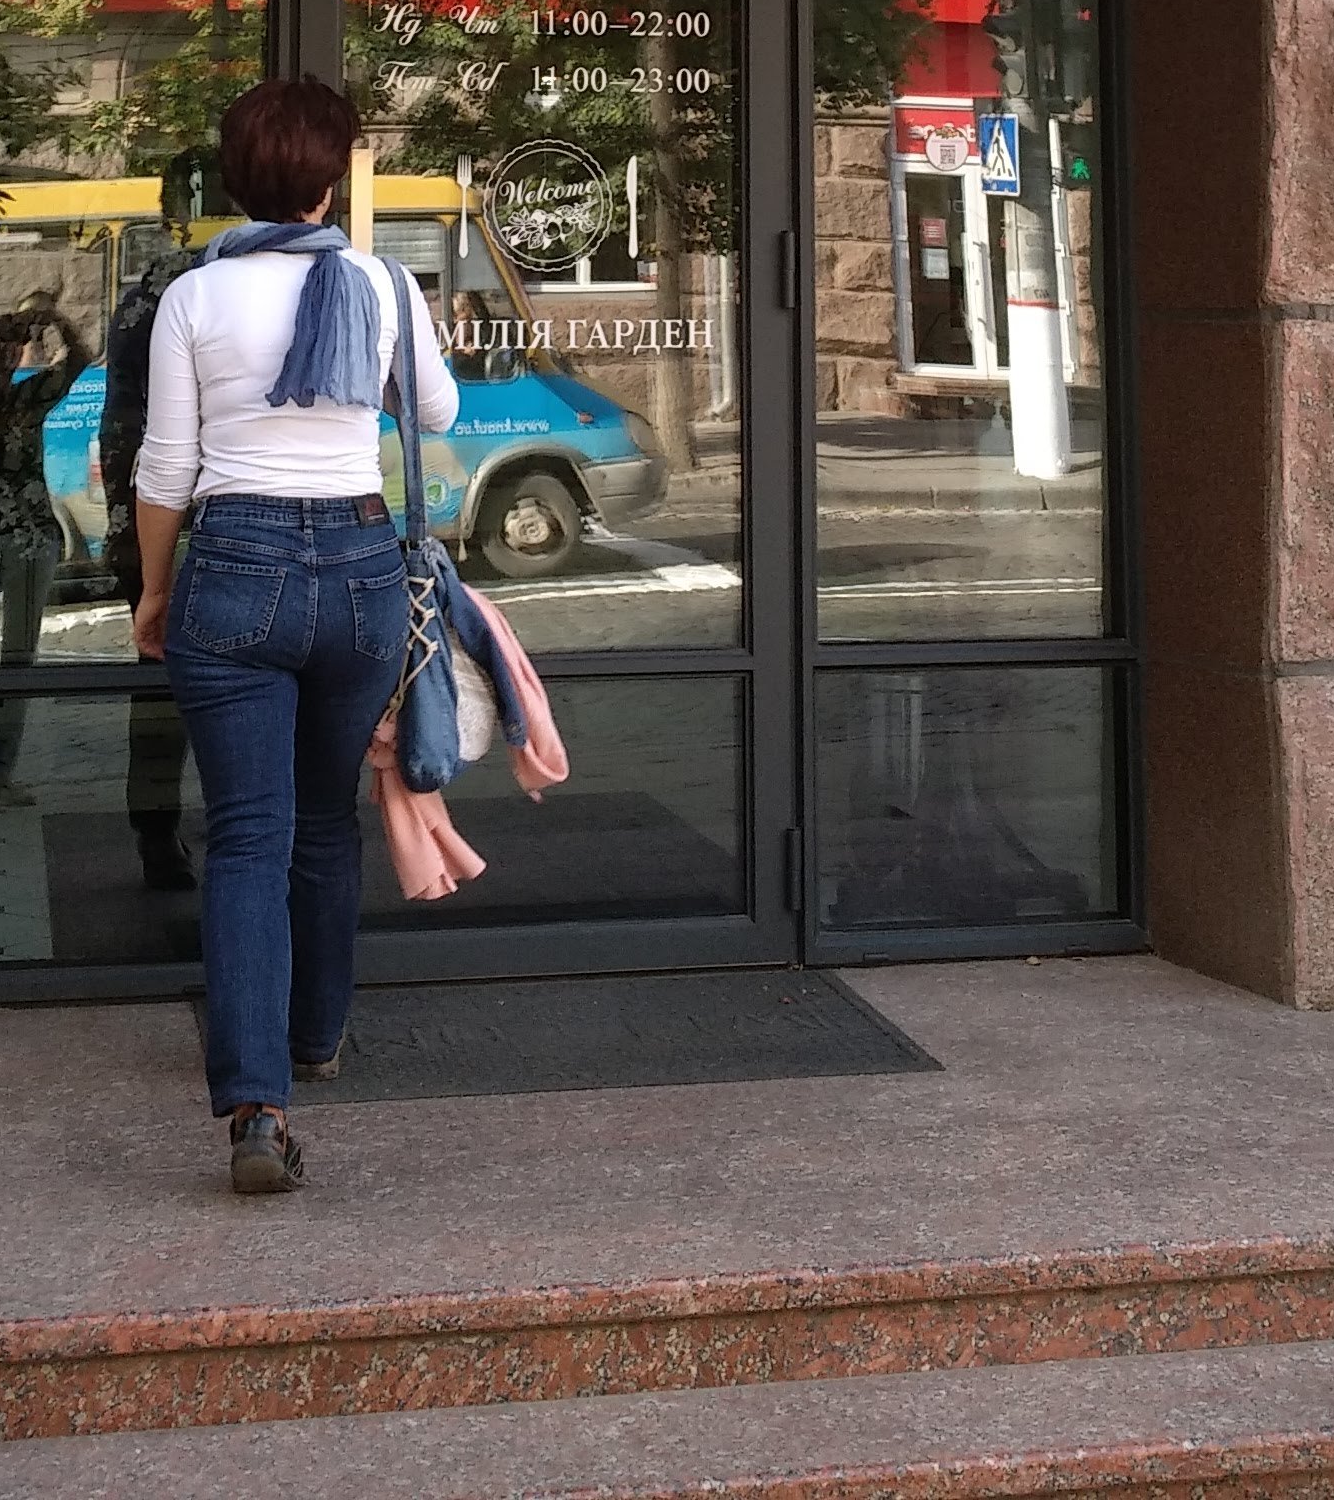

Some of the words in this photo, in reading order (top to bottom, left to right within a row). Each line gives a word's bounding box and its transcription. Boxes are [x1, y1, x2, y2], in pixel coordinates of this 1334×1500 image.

[499, 177, 597, 205] Welcome
[436, 319, 554, 351] МІЛІЯ
[566, 318, 715, 356] ГАРДЕН
